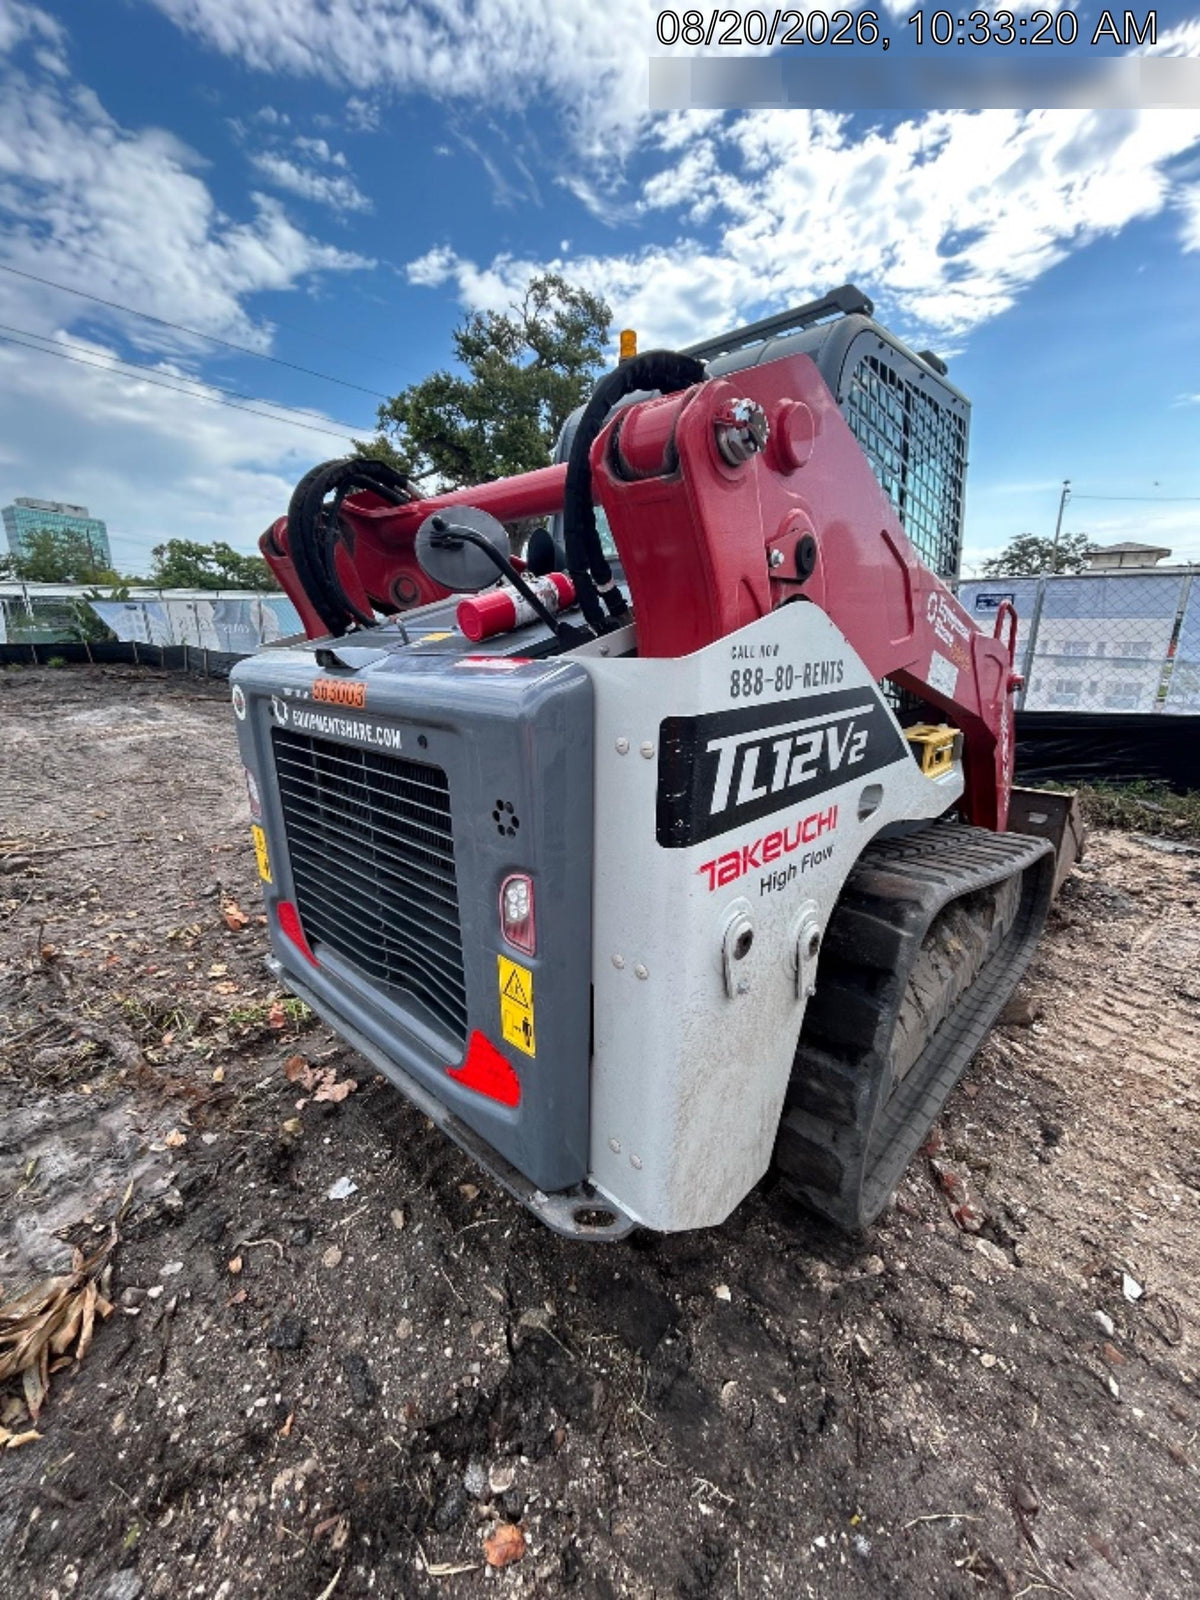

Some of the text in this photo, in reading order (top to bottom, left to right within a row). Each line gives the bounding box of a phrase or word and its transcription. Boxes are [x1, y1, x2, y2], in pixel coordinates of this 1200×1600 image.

[731, 643, 780, 660] CALL NOW
[730, 659, 844, 698] 888-80-RENTS
[292, 709, 402, 750] EQUIPMENTSHARE.COM
[759, 843, 835, 897] High Flow
